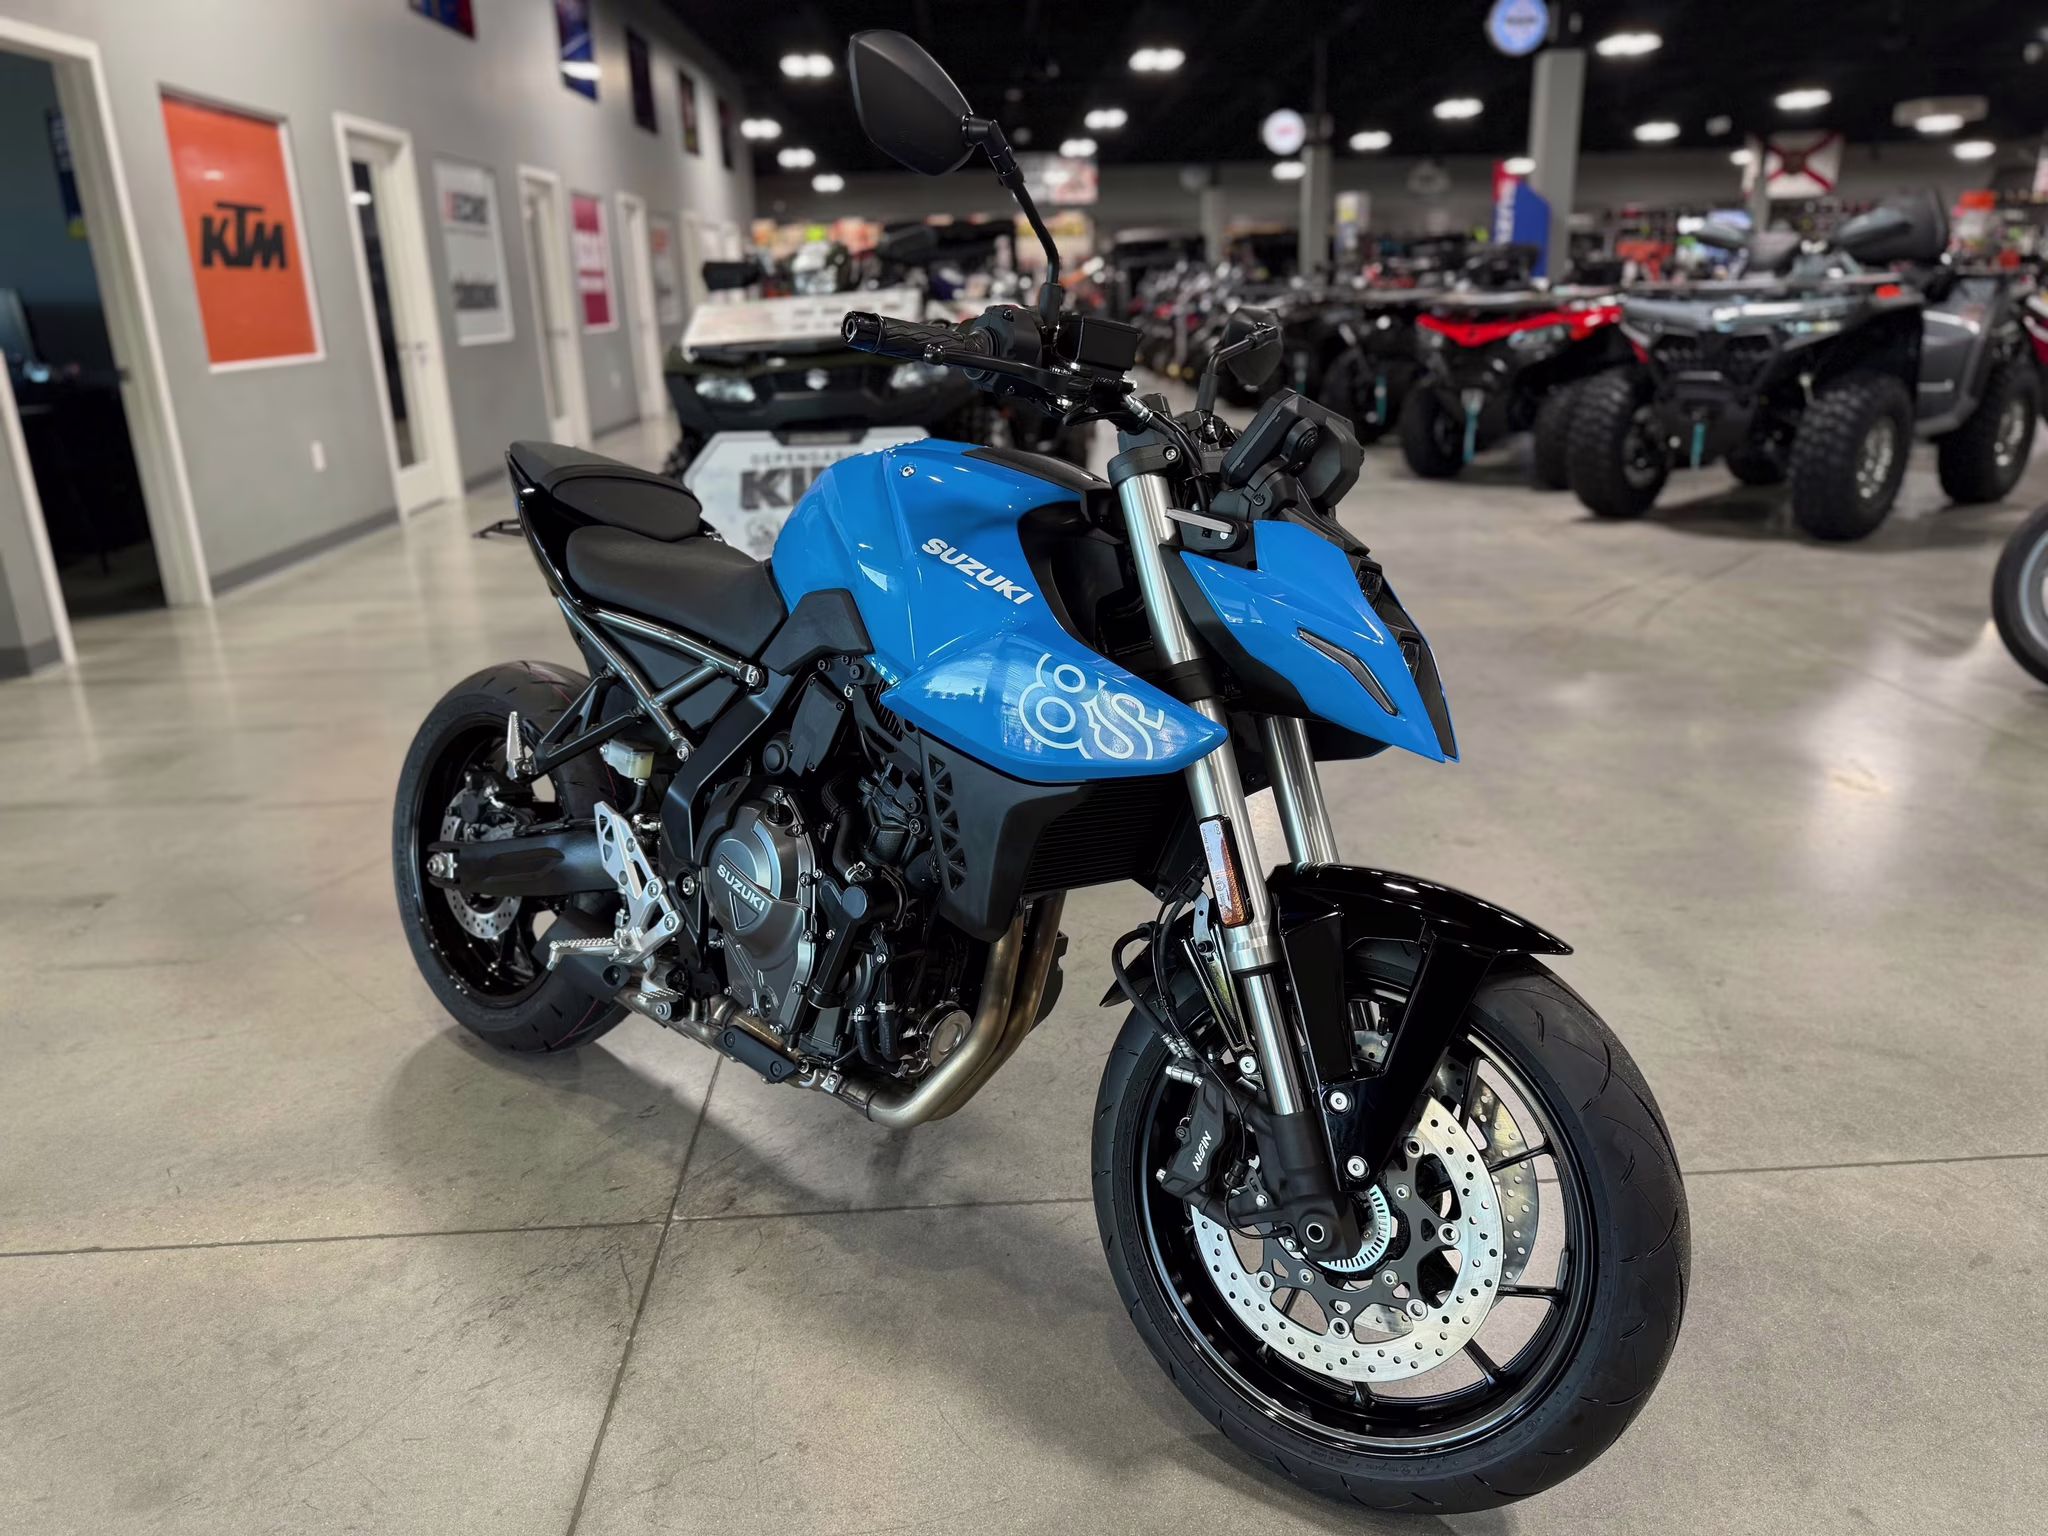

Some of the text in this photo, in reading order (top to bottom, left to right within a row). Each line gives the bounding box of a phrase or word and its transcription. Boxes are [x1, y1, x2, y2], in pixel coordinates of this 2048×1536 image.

[202, 201, 286, 269] KTM
[741, 466, 827, 510] KI
[921, 538, 1034, 605] SUZUKI
[717, 864, 766, 912] SUZUKI
